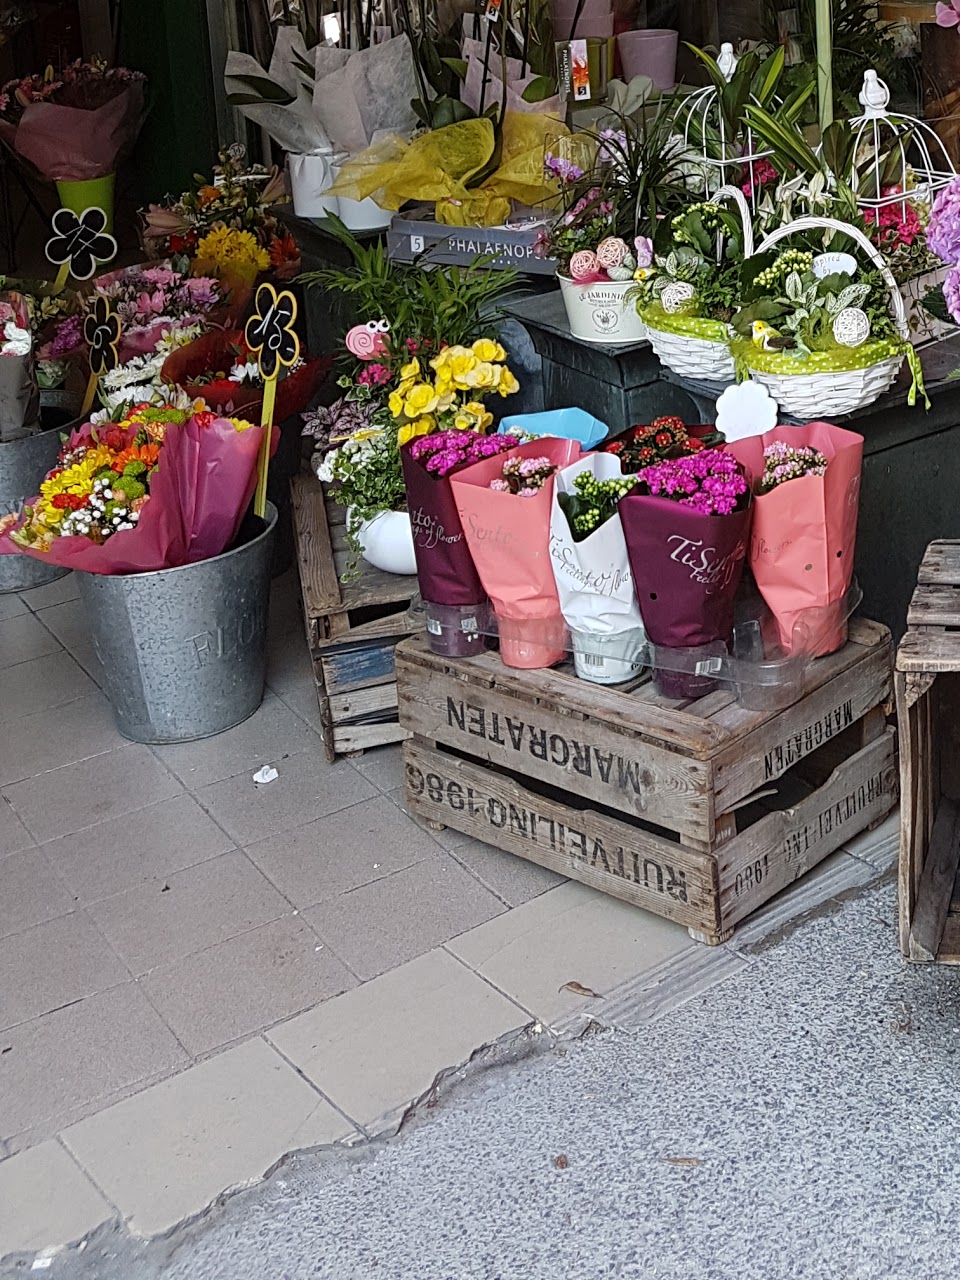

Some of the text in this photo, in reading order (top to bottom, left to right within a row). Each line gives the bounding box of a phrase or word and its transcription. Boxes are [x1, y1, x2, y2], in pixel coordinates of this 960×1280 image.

[413, 237, 422, 251] 5
[446, 695, 641, 797] MARGRATEN
[763, 697, 854, 782] MARGRATEN
